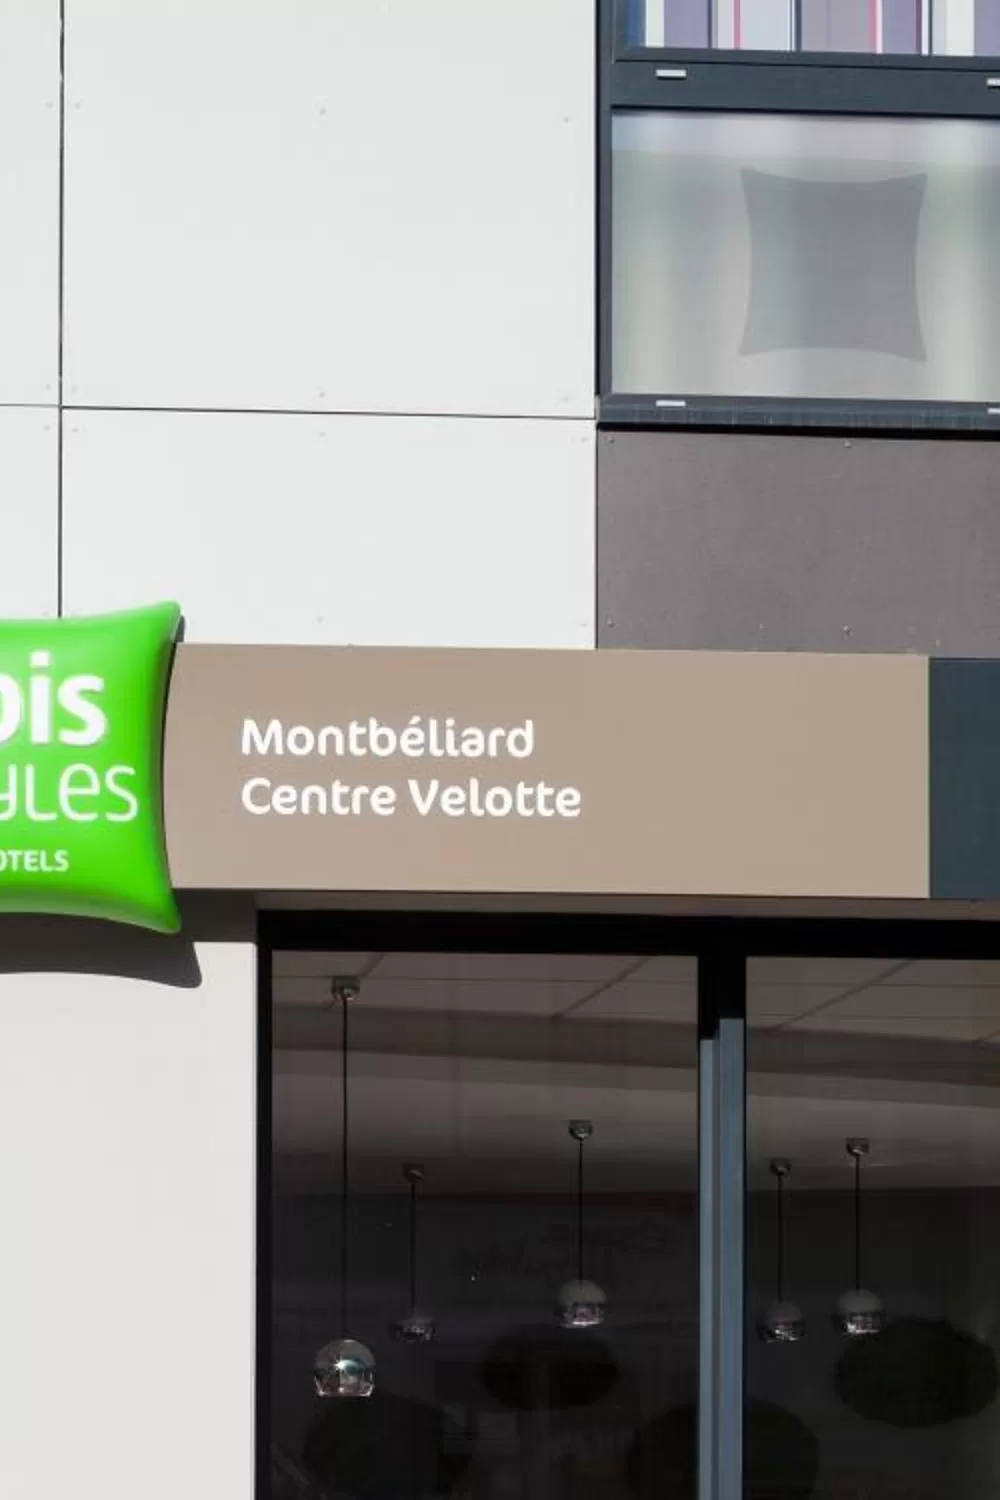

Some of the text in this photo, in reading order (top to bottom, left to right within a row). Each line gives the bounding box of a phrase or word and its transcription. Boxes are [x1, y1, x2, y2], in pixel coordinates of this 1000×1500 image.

[241, 716, 534, 758] Montbéliard
[241, 776, 582, 817] Centre Velotte
